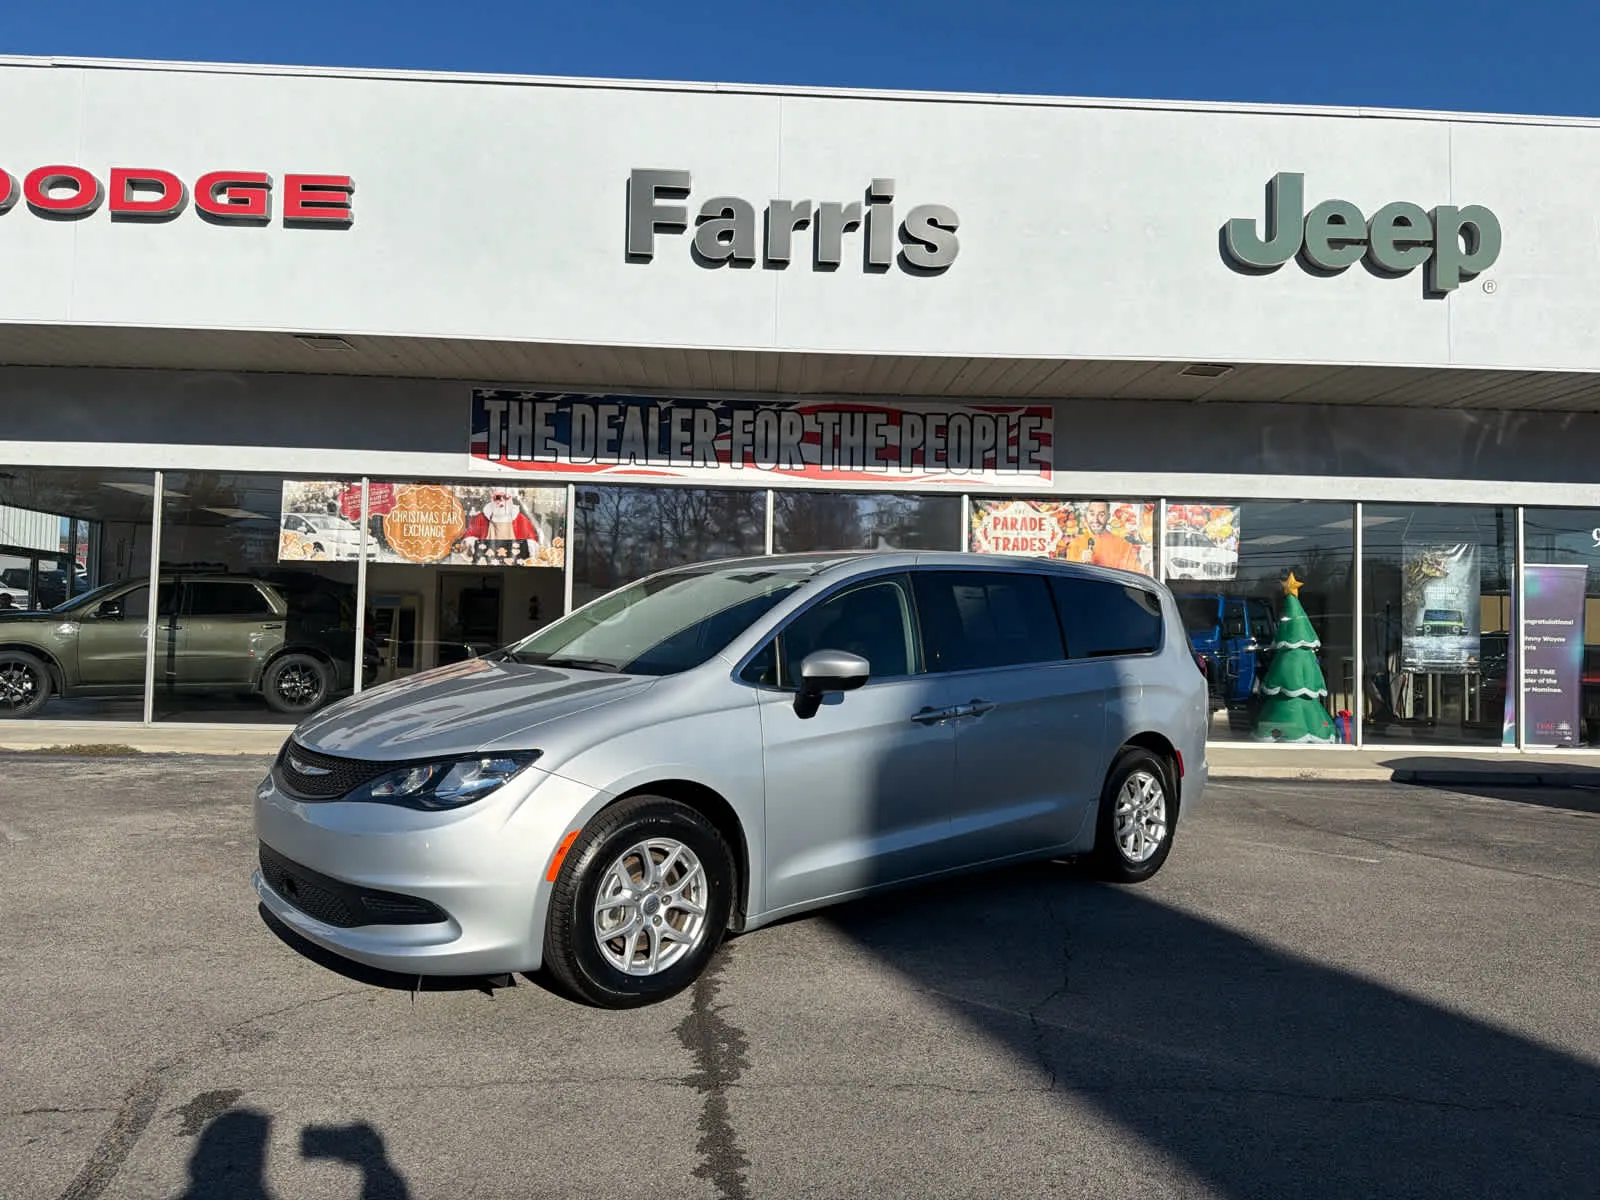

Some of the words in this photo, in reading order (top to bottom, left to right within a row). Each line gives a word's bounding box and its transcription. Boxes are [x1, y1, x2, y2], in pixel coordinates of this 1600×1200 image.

[0, 164, 355, 231] ODGE
[625, 168, 961, 277] Farris
[1219, 172, 1502, 300] Jeep
[484, 399, 557, 463] THE
[568, 402, 719, 469] DEALER
[730, 407, 804, 471] FOR
[816, 410, 889, 473] THE
[899, 412, 1042, 476] PEOPLE
[392, 510, 438, 524] CHRISTMAS
[441, 512, 459, 525] CAR
[992, 516, 1047, 532] PARADE
[403, 524, 446, 538] EXCHANGE
[992, 536, 1047, 552] TRADES
[1542, 635, 1566, 643] Wayne
